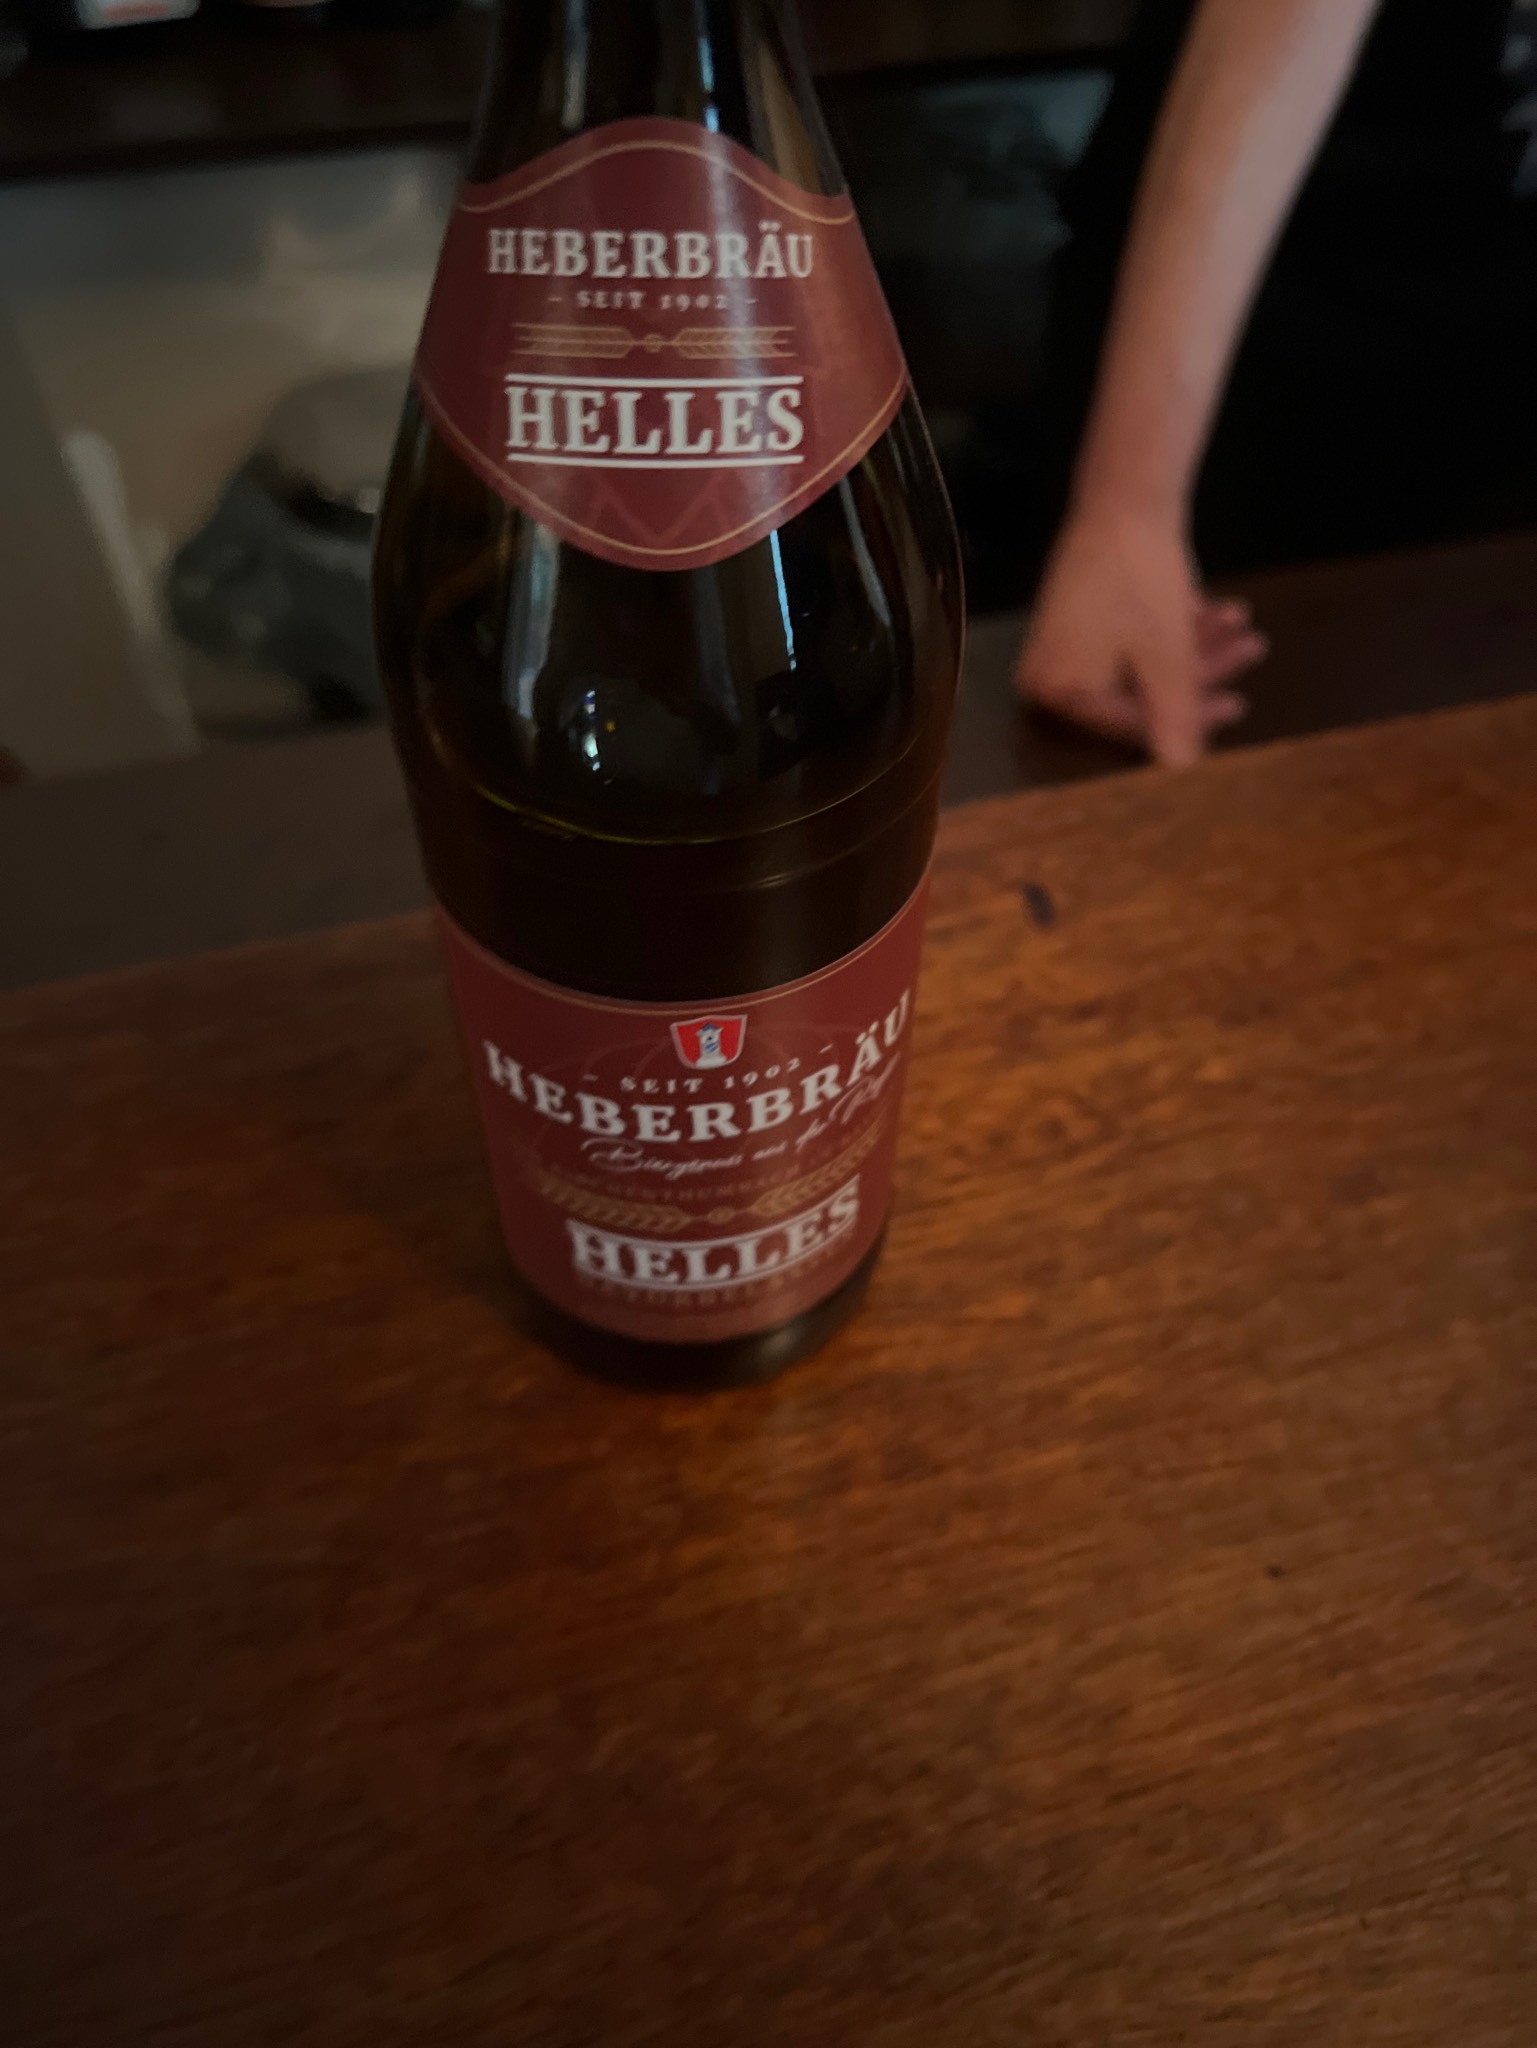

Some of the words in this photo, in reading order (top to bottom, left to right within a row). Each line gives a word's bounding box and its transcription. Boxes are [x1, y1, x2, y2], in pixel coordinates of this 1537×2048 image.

[487, 219, 814, 279] HEBERBRÄU
[575, 289, 646, 310] SEIT
[659, 294, 729, 312] 1902
[504, 386, 804, 455] HELLES
[482, 987, 911, 1144] HEBERBRÄU
[619, 1075, 704, 1094] SEIT
[723, 1056, 801, 1091] 1902
[569, 1186, 861, 1288] HELLES
